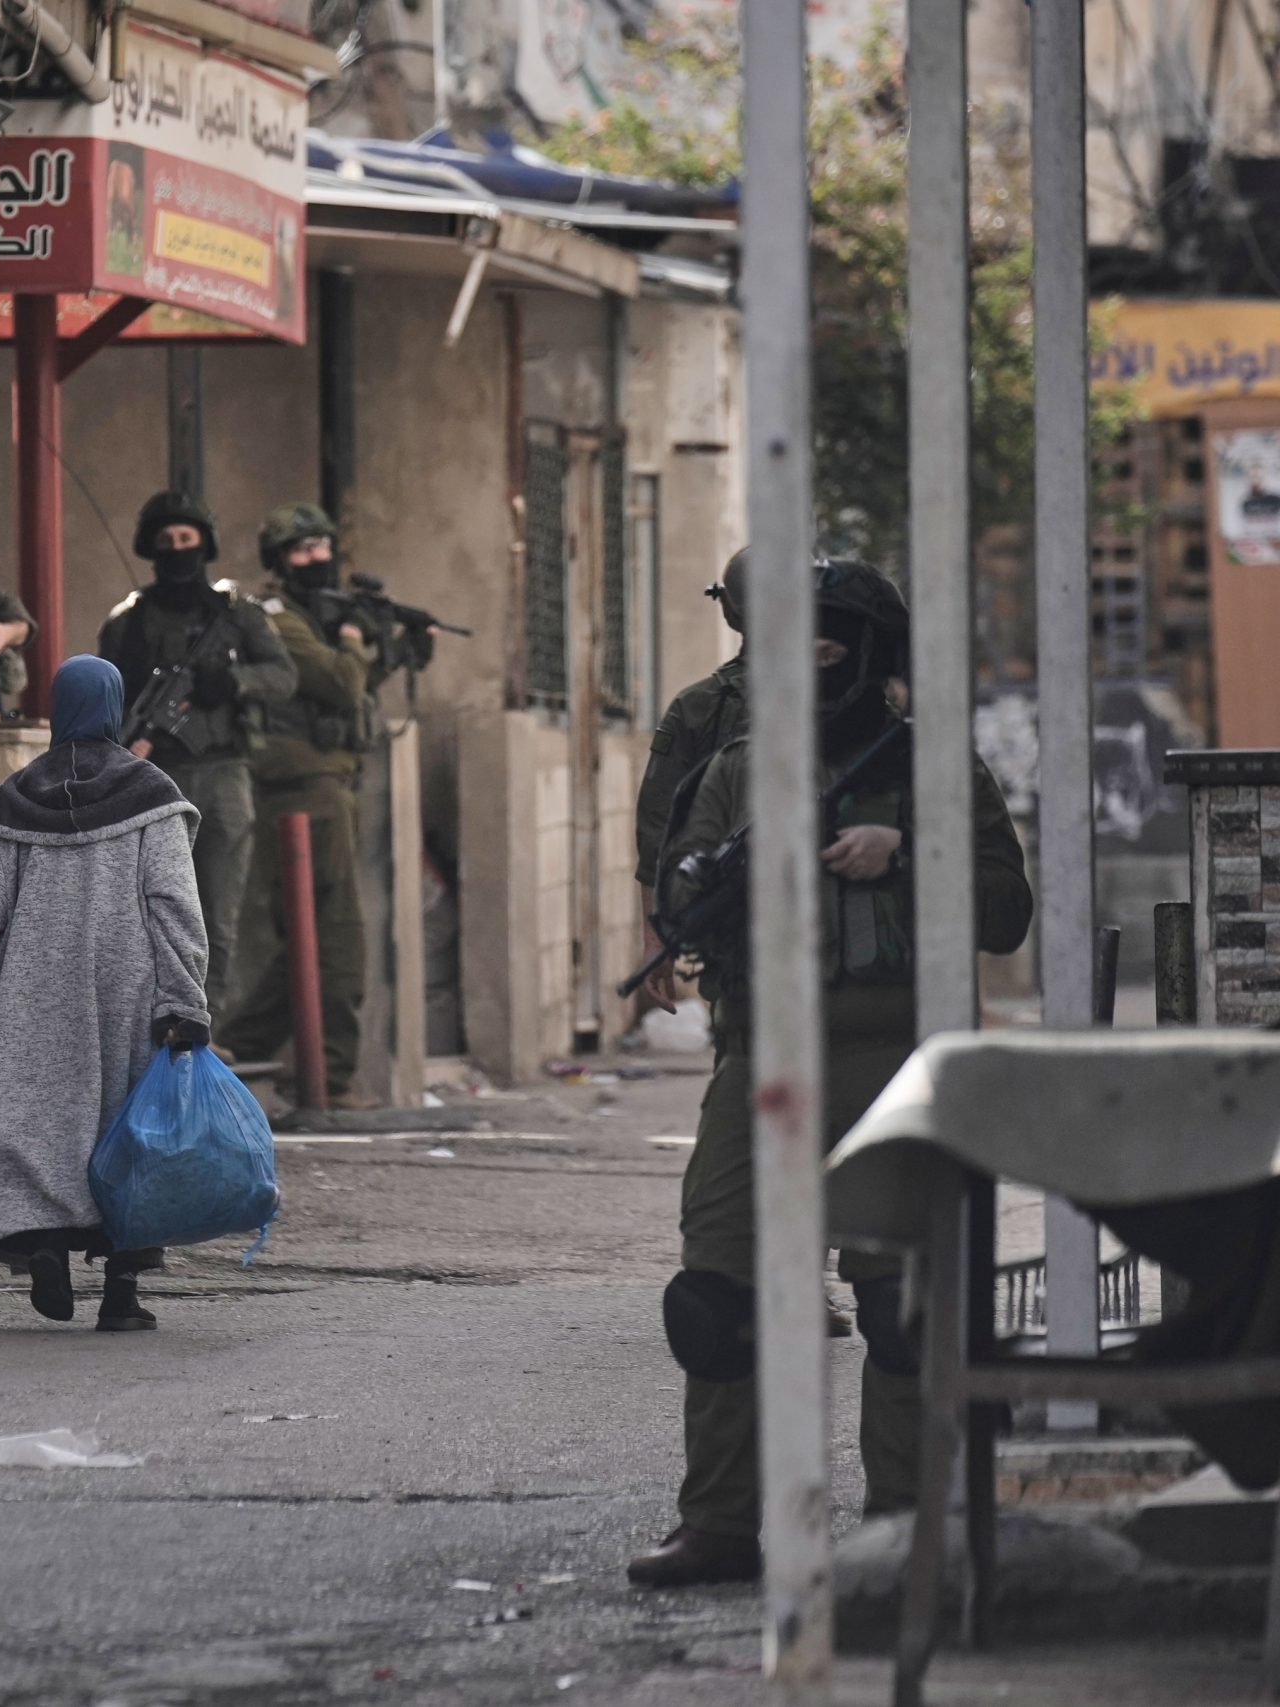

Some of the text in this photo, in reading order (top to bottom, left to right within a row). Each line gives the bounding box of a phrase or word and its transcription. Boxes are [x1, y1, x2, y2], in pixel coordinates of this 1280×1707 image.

[113, 52, 296, 162] ملحمة الجميل الطيراوي
